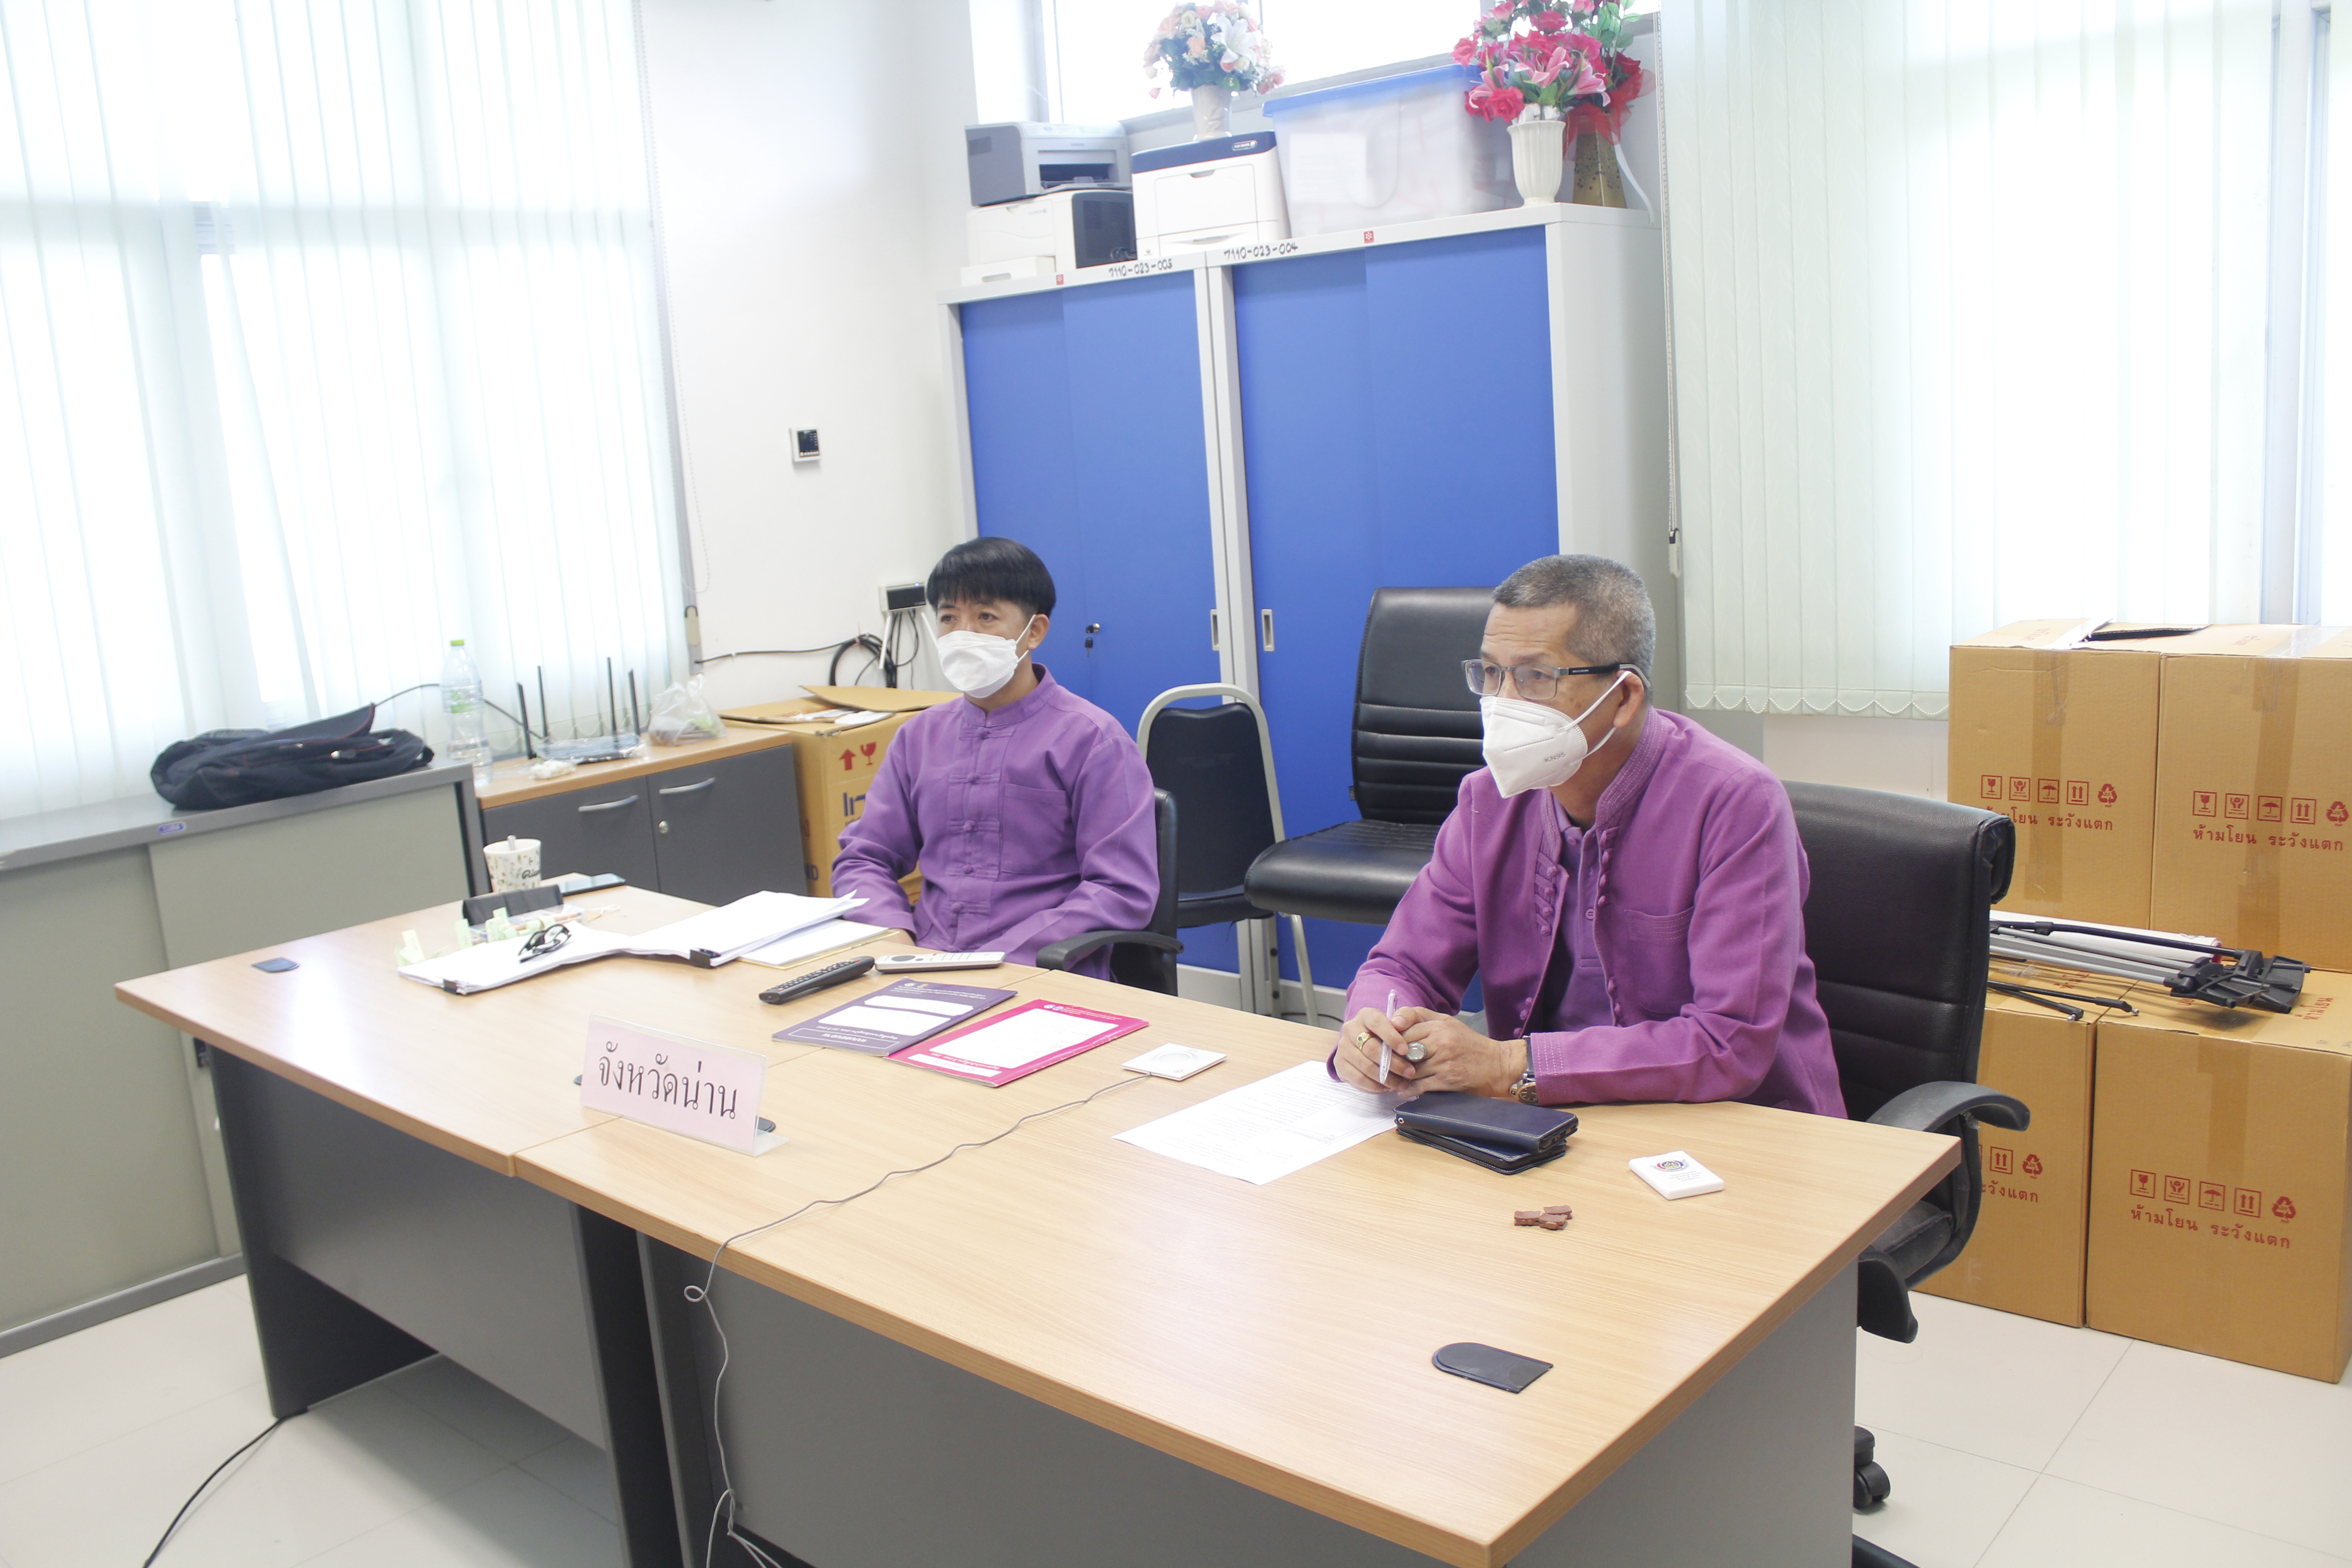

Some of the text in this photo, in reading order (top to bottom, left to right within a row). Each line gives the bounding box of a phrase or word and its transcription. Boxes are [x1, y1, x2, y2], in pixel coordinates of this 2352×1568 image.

[1224, 242, 1298, 262] 7110-023-004
[1108, 258, 1173, 277] 7110-023-005
[1544, 752, 1566, 764] KN95
[2048, 813, 2113, 831] ระวังแตก
[2193, 824, 2343, 851] ห้ามโยน ระวังแตก
[598, 1040, 738, 1120] จังหวัดน่าน
[2130, 1204, 2290, 1249] ห้ามโยน ระวังแตก
